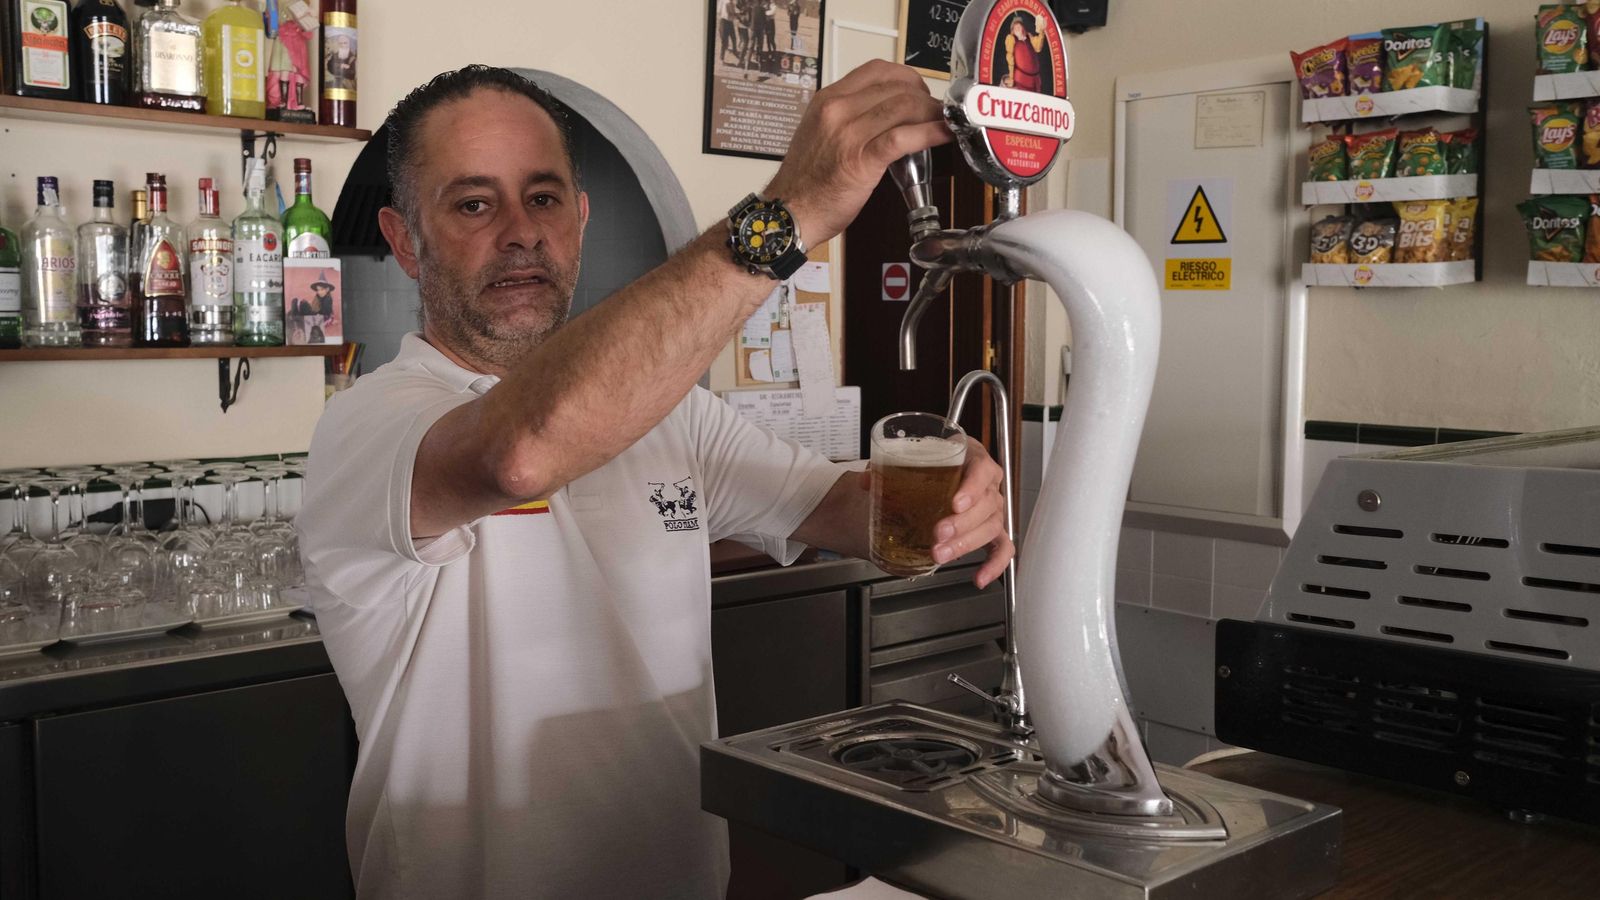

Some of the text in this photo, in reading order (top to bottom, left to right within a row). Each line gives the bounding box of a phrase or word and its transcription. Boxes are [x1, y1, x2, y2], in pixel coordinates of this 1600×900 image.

[1384, 37, 1432, 51] Doritos
[761, 101, 797, 111] OROZCO
[977, 89, 1070, 132] Cruzcampo
[1005, 134, 1043, 150] ESPECIAL
[1532, 216, 1580, 230] Doritos
[1399, 232, 1433, 248] Bits
[41, 257, 76, 269] ARIOS
[1180, 261, 1217, 271] RIESGO
[1172, 271, 1225, 281] ELECTRICO
[664, 521, 682, 530] POLO
